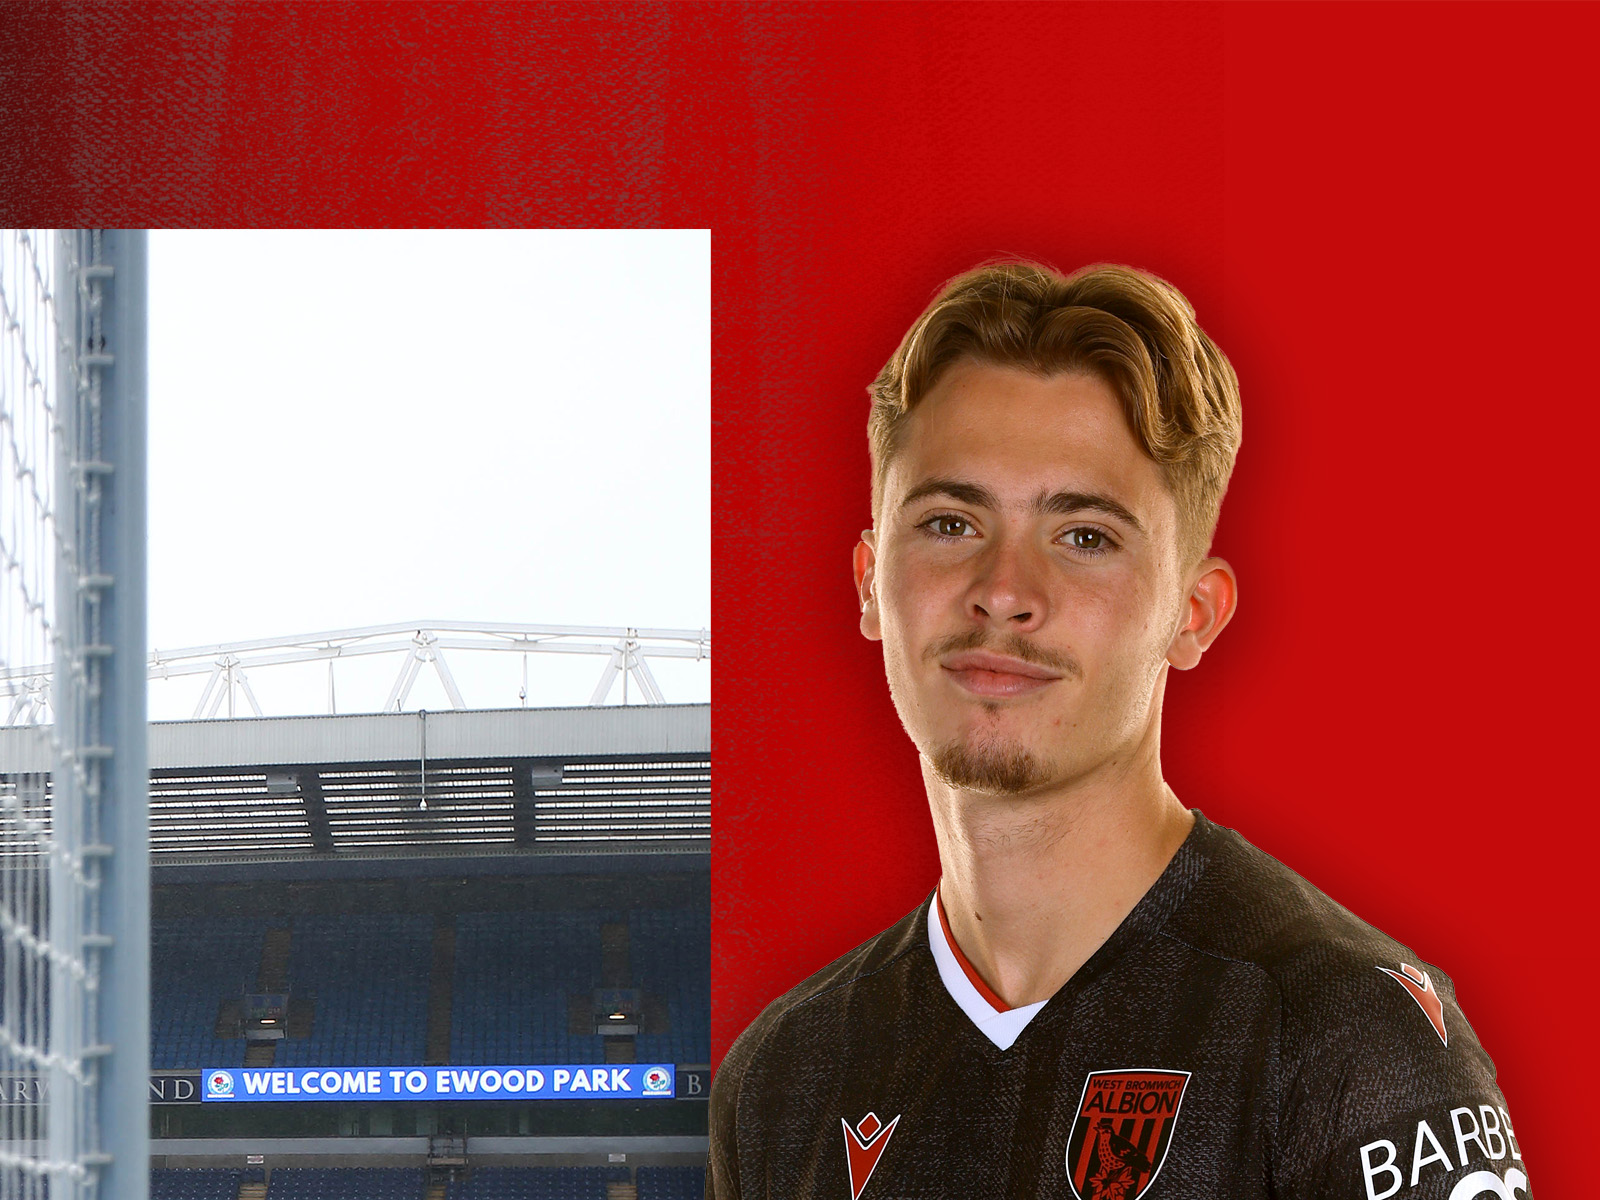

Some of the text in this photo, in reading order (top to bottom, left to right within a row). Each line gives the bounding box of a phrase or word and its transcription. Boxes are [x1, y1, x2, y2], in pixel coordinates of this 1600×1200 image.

[242, 1068, 632, 1094] WELCOME TO EWOOD PARK
[1093, 1079, 1182, 1090] WEST BROMWICH
[1085, 1091, 1178, 1114] ALBION
